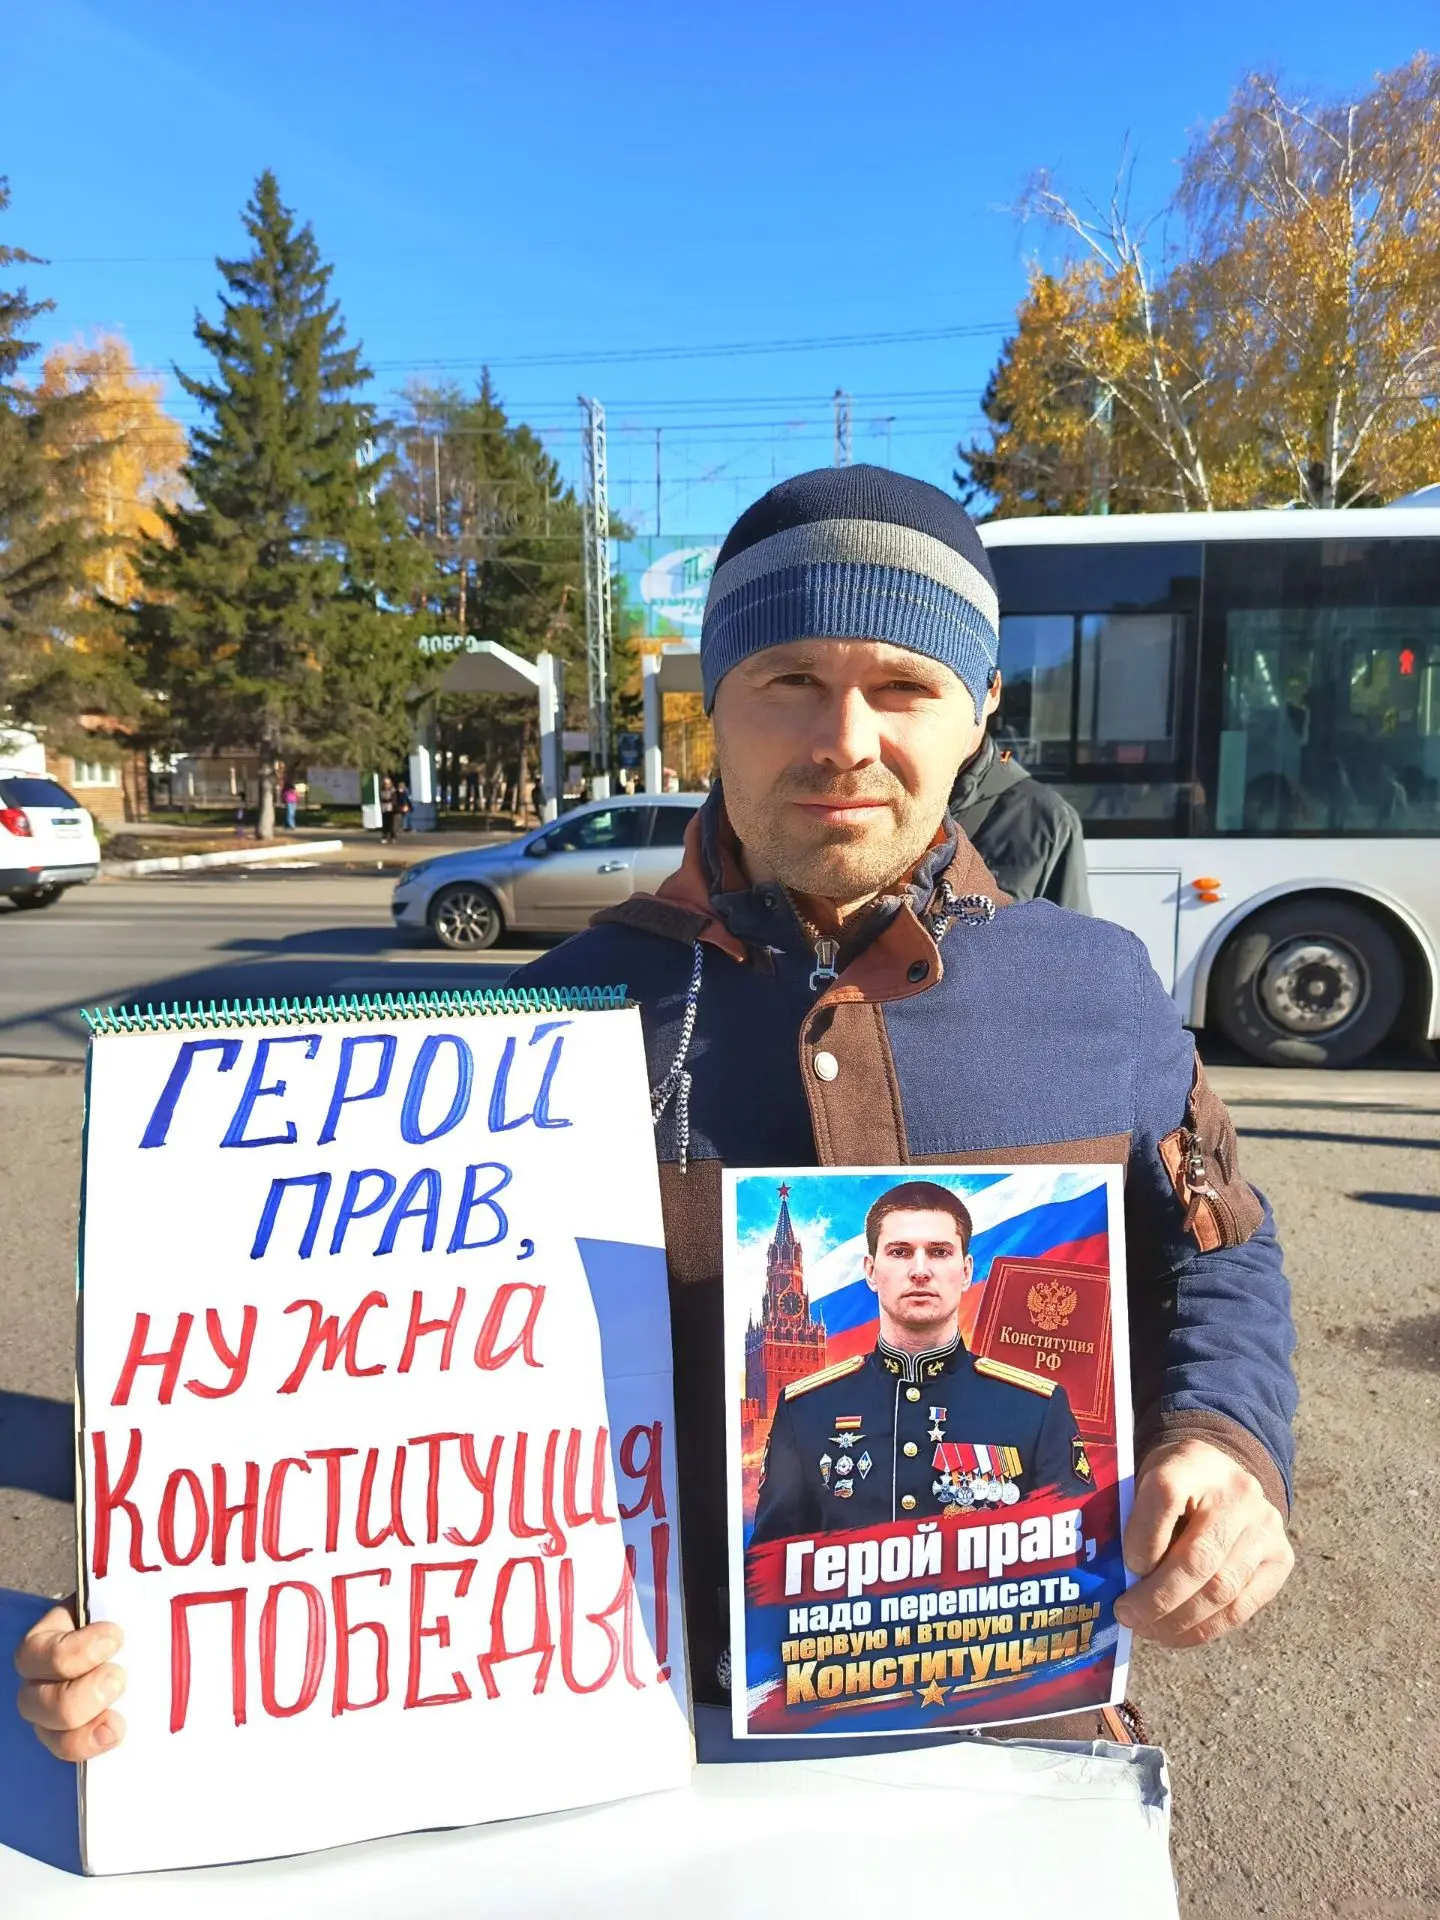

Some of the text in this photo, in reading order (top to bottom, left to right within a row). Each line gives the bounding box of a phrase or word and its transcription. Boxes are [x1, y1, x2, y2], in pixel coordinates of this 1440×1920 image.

[138, 1021, 574, 1148] ГЕРОЙ
[250, 1162, 535, 1260] ПРАВ,
[111, 1282, 547, 1406] НУЖНА
[999, 1326, 1095, 1354] Конституция
[1035, 1352, 1062, 1371] РФ
[785, 1507, 1097, 1597] Герой прав,
[169, 1523, 670, 1734] ПОБЕДЫ!
[781, 1600, 1101, 1662] первую и вторую главы
[789, 1574, 1080, 1634] надо переписать
[786, 1621, 1094, 1705] Конституции!
